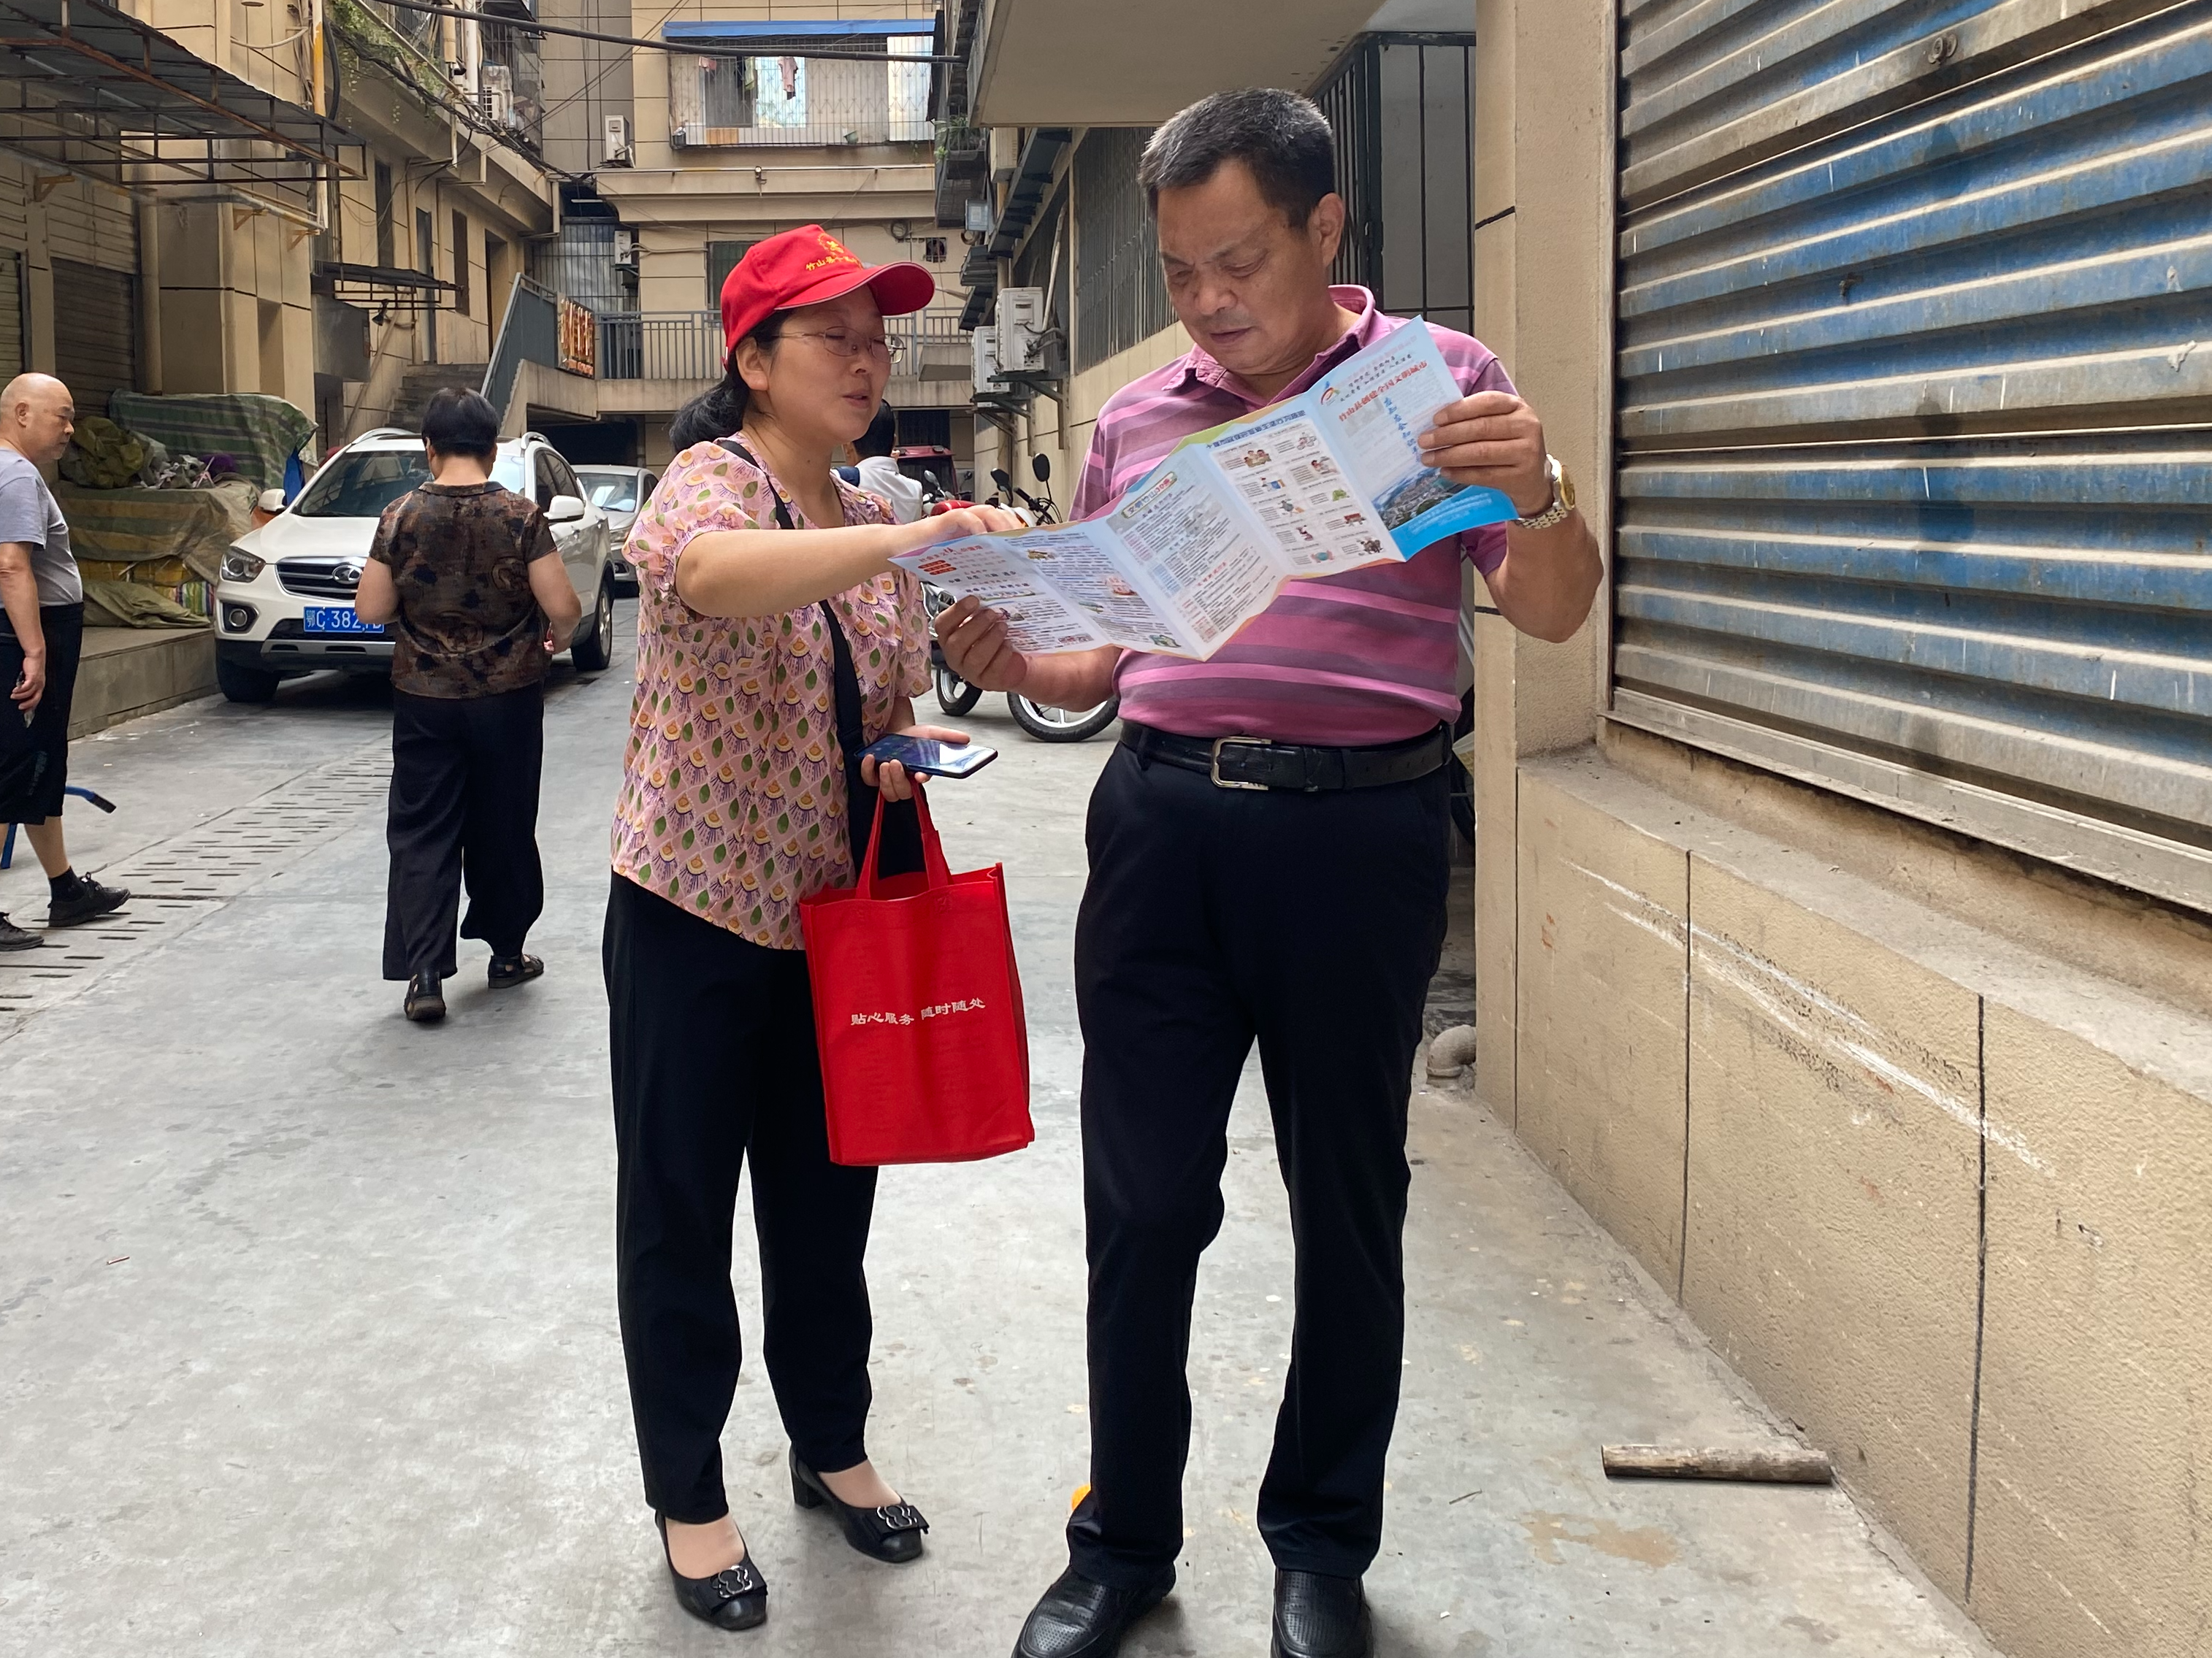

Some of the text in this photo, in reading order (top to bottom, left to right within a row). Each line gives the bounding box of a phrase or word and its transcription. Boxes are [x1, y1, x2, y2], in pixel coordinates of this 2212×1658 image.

[306, 610, 381, 629] 鄂C·382
[850, 997, 986, 1026] 贴心服务 随时随处
